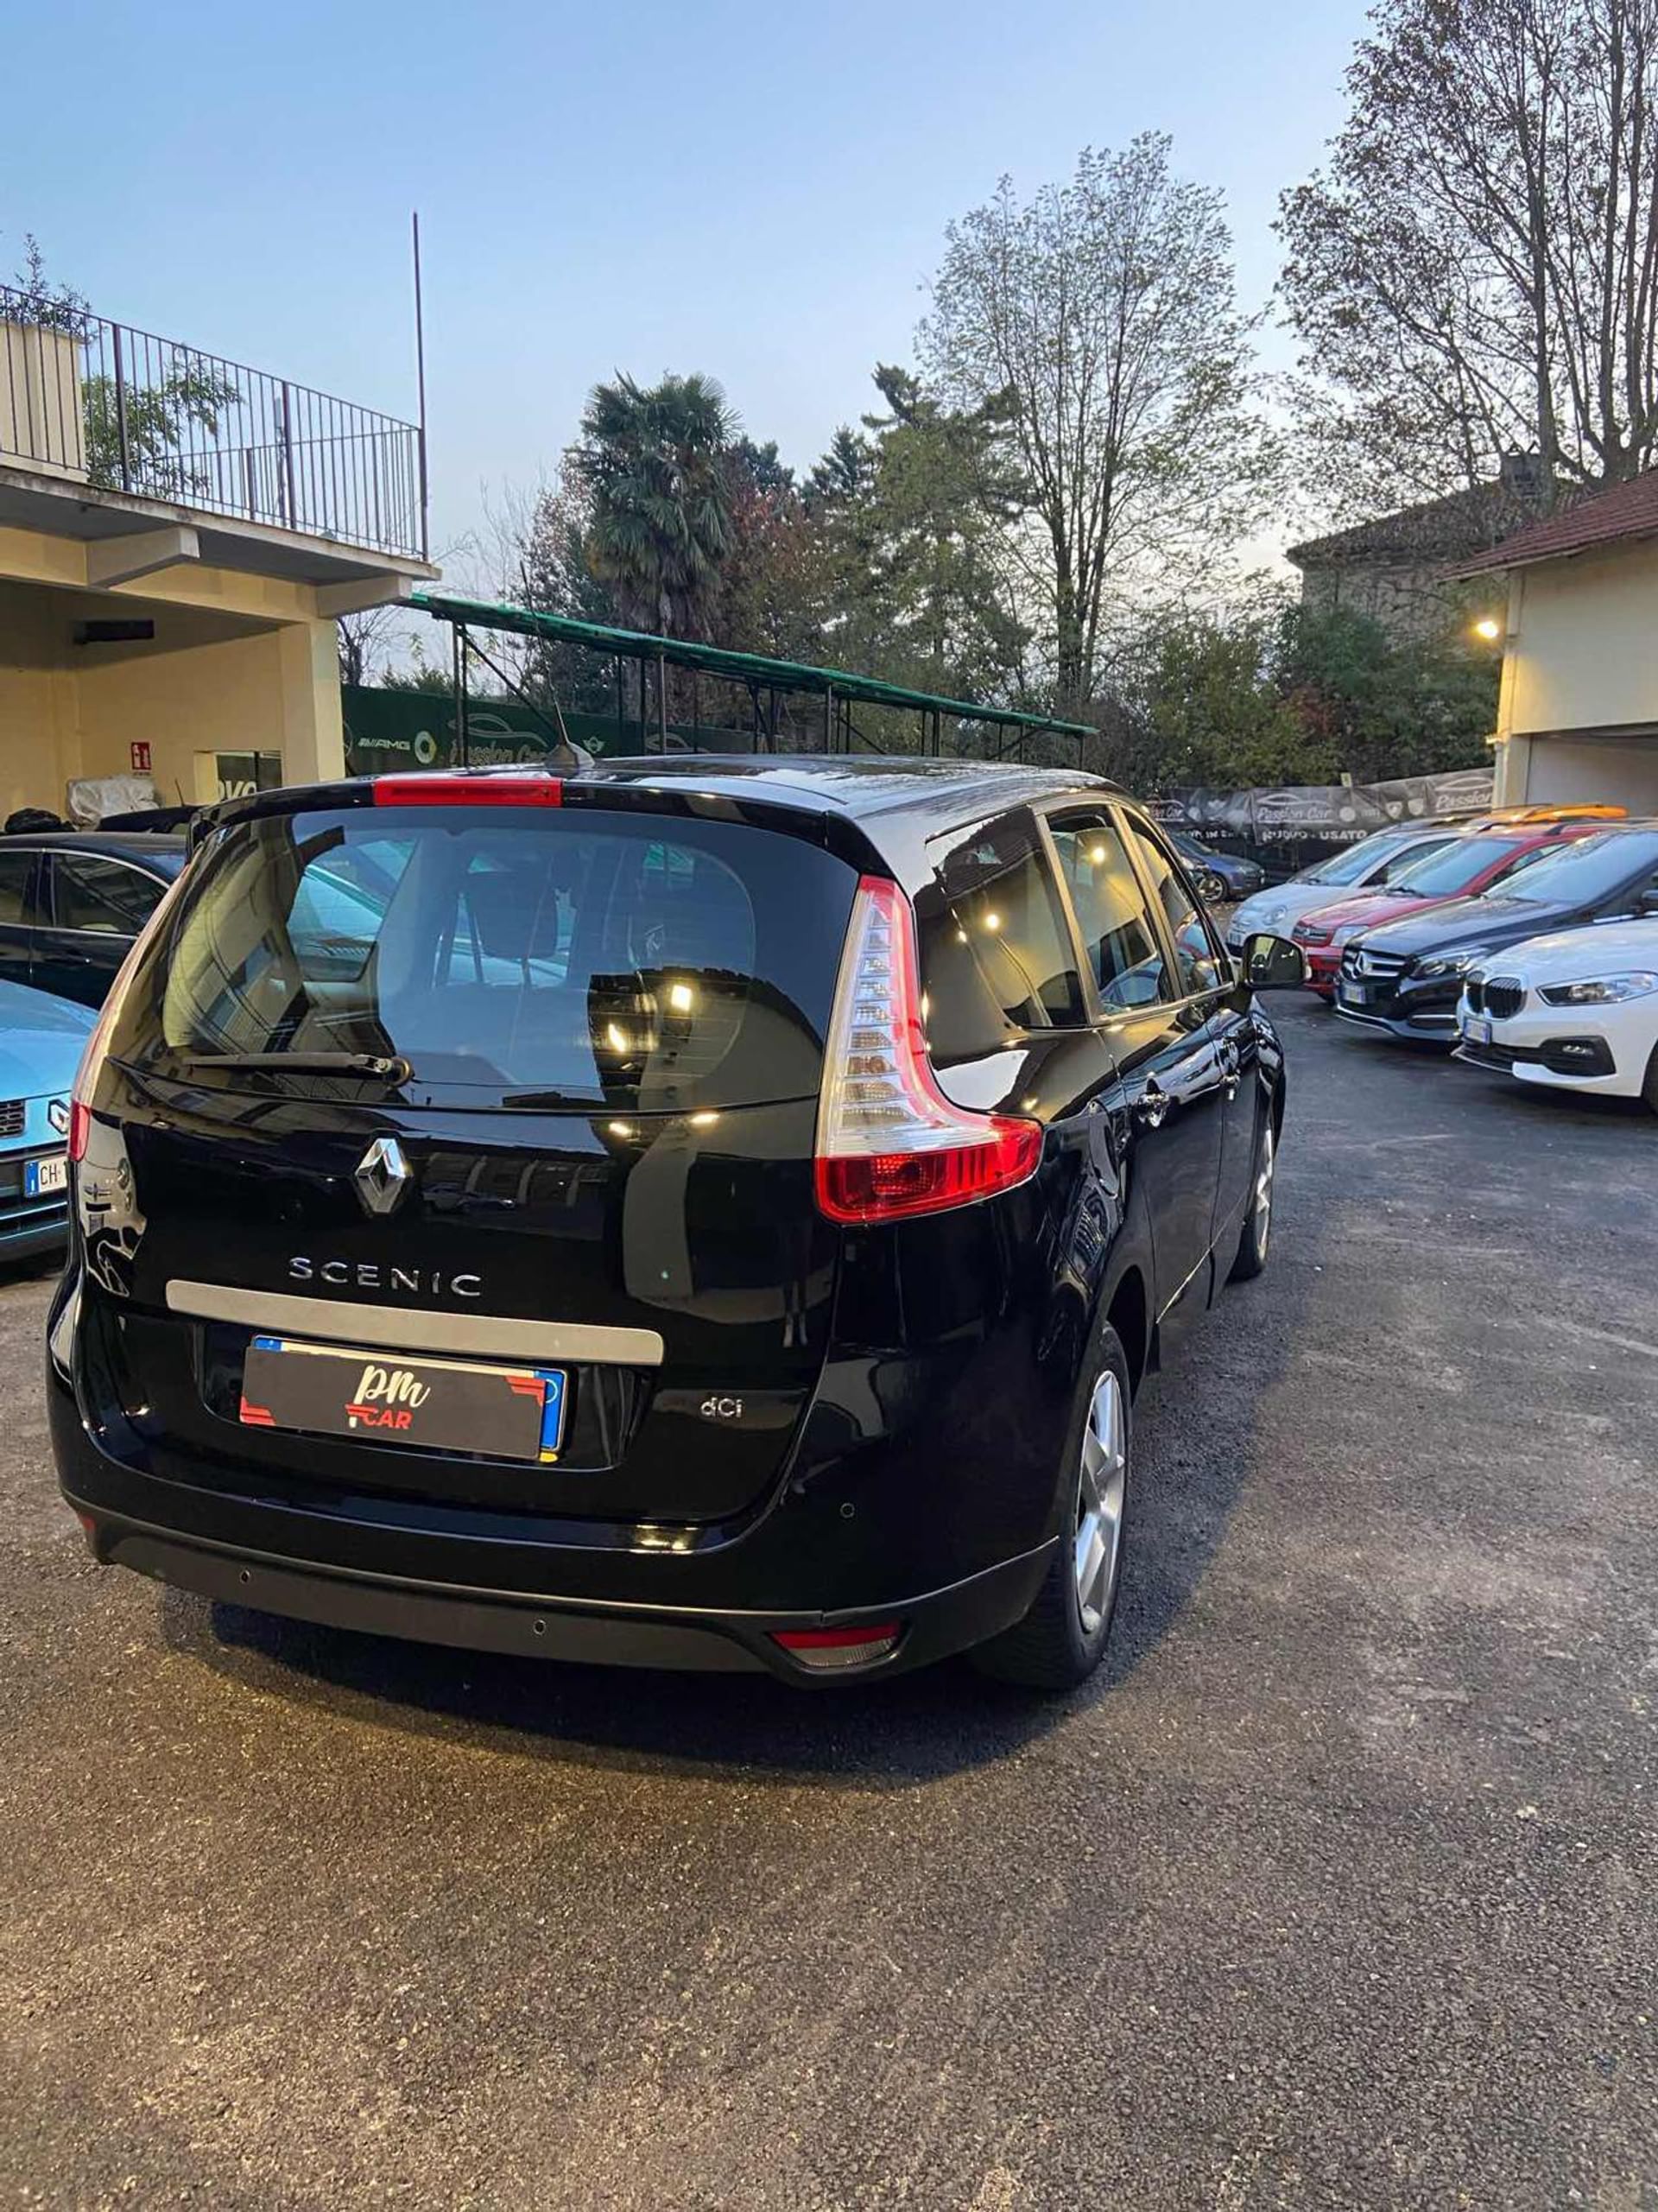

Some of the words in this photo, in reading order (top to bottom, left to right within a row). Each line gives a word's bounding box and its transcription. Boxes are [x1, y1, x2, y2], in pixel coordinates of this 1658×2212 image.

[1307, 806, 1333, 821] Car
[1319, 829, 1367, 840] USATO
[288, 1257, 482, 1296] SCENIC
[700, 1397, 743, 1417] dCi
[357, 1408, 413, 1429] CAR
